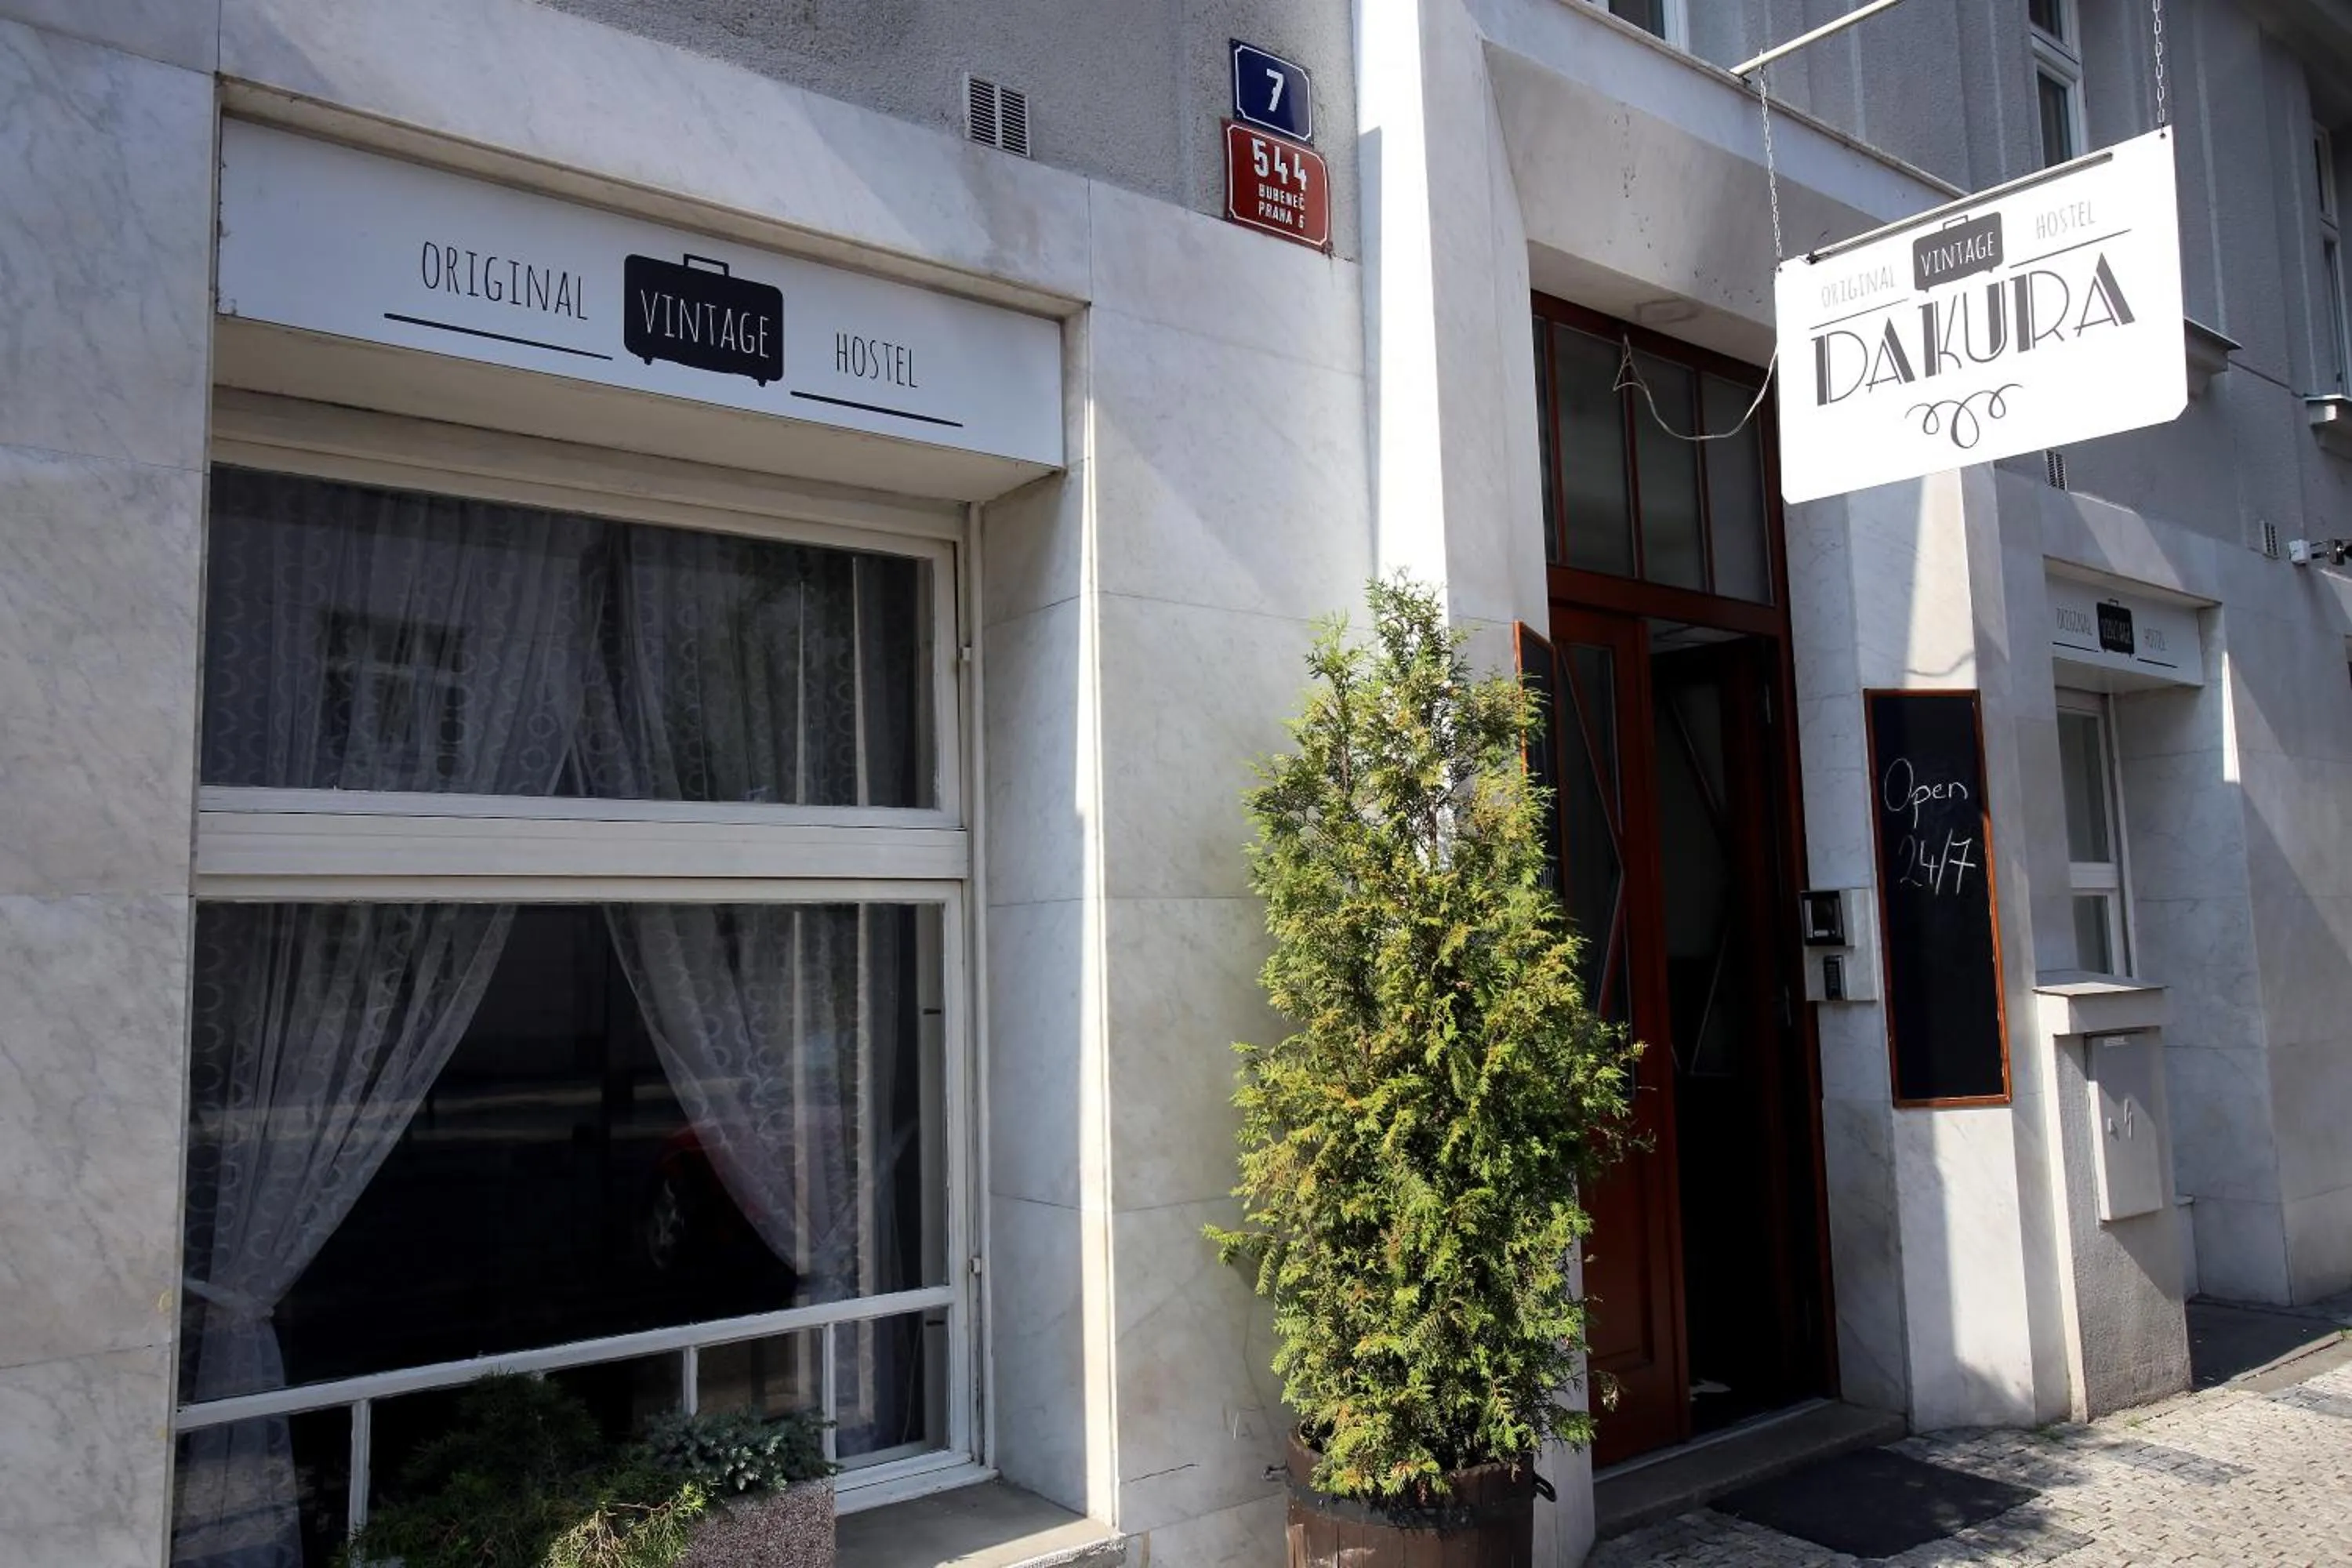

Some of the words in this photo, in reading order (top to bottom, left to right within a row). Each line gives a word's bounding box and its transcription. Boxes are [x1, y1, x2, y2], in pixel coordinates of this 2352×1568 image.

[1266, 68, 1284, 112] 7
[1251, 138, 1307, 191] 544
[1258, 201, 1293, 225] PRAHA
[1820, 265, 1896, 308] ORIGINAL
[1920, 231, 1995, 277] VINTAGE
[2035, 201, 2096, 239] HOSTEL
[421, 241, 588, 321] ORIGINAL
[640, 289, 770, 359] VINTAGE
[836, 332, 919, 388] HOSTEL
[1810, 252, 2136, 407] DAKURA
[1884, 758, 1969, 829] Open
[1898, 829, 1976, 895] 24/7
